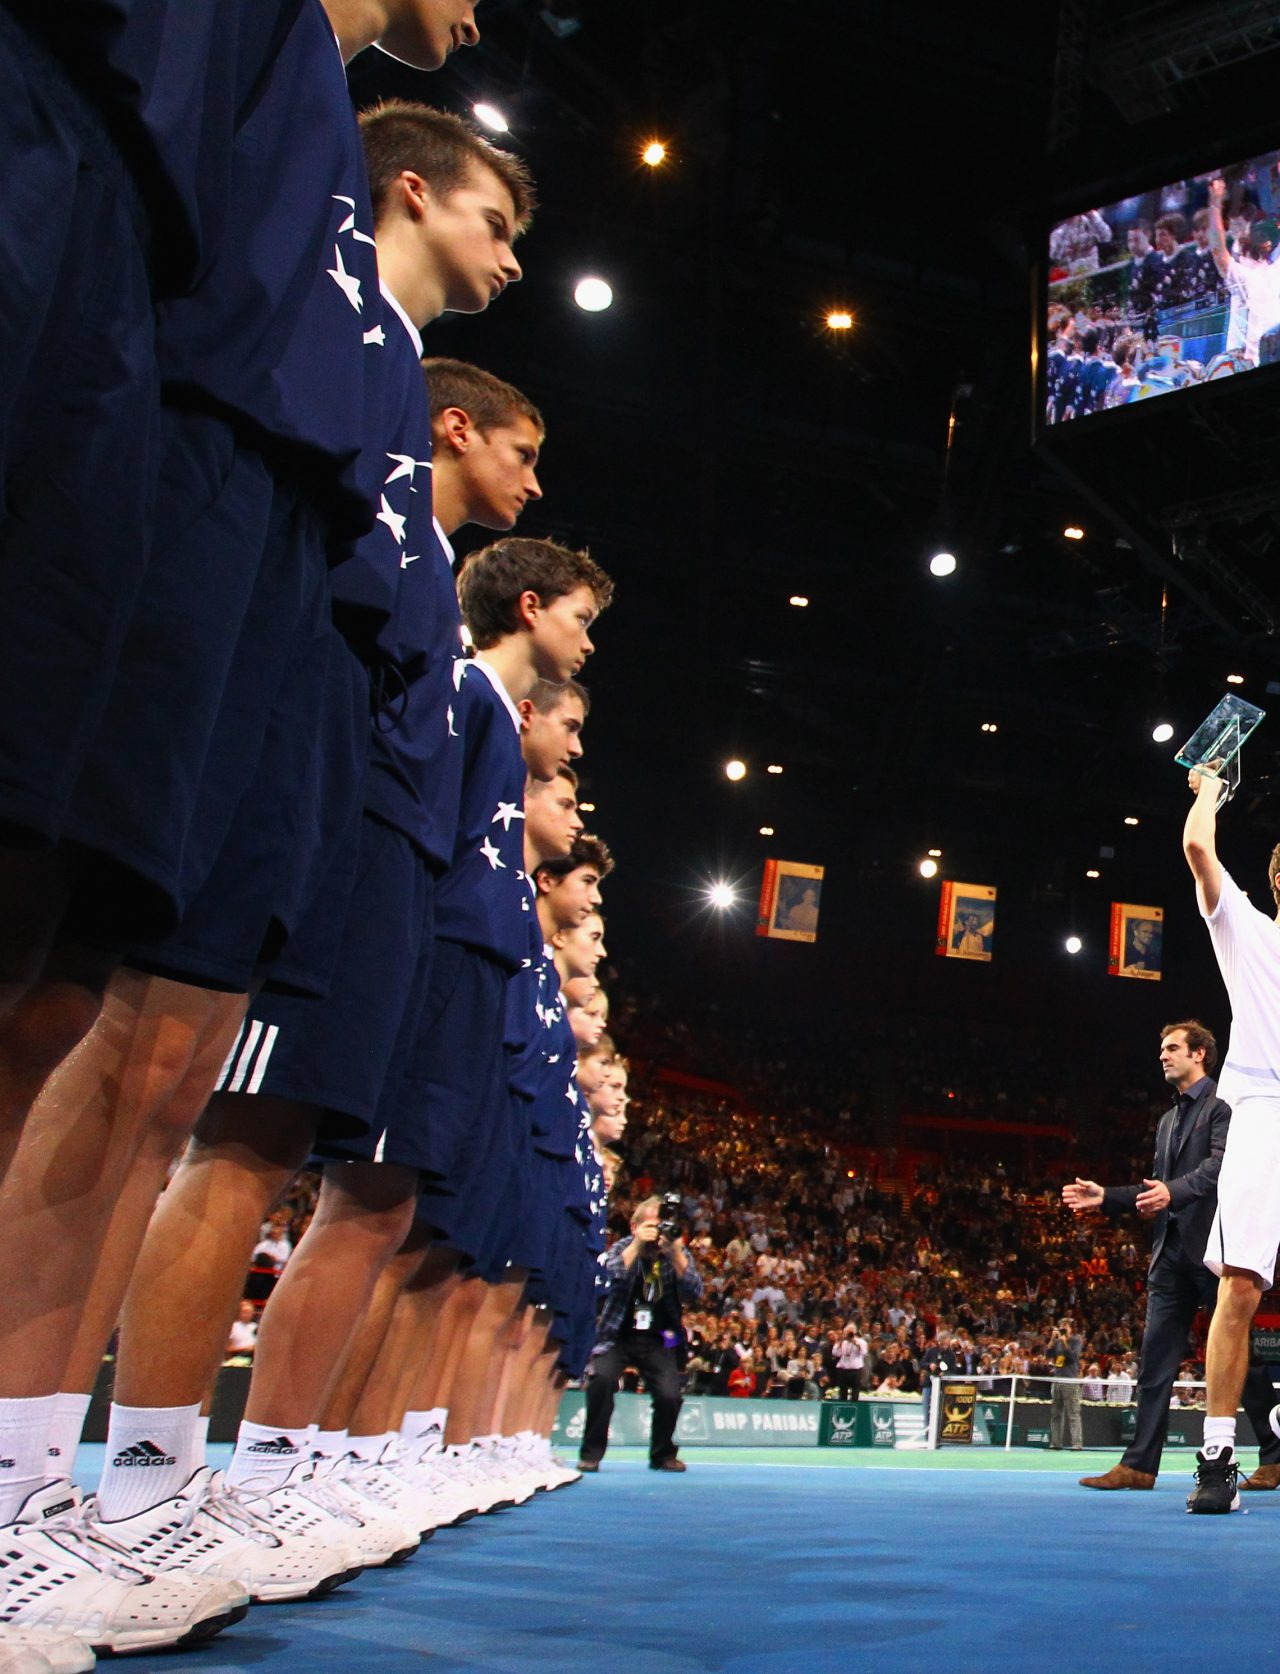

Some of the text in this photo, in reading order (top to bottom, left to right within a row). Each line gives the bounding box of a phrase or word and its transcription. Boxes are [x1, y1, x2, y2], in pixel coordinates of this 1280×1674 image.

[713, 1411, 818, 1431] BNP PARIBAS
[247, 1445, 300, 1455] adidas
[113, 1456, 177, 1467] adidas
